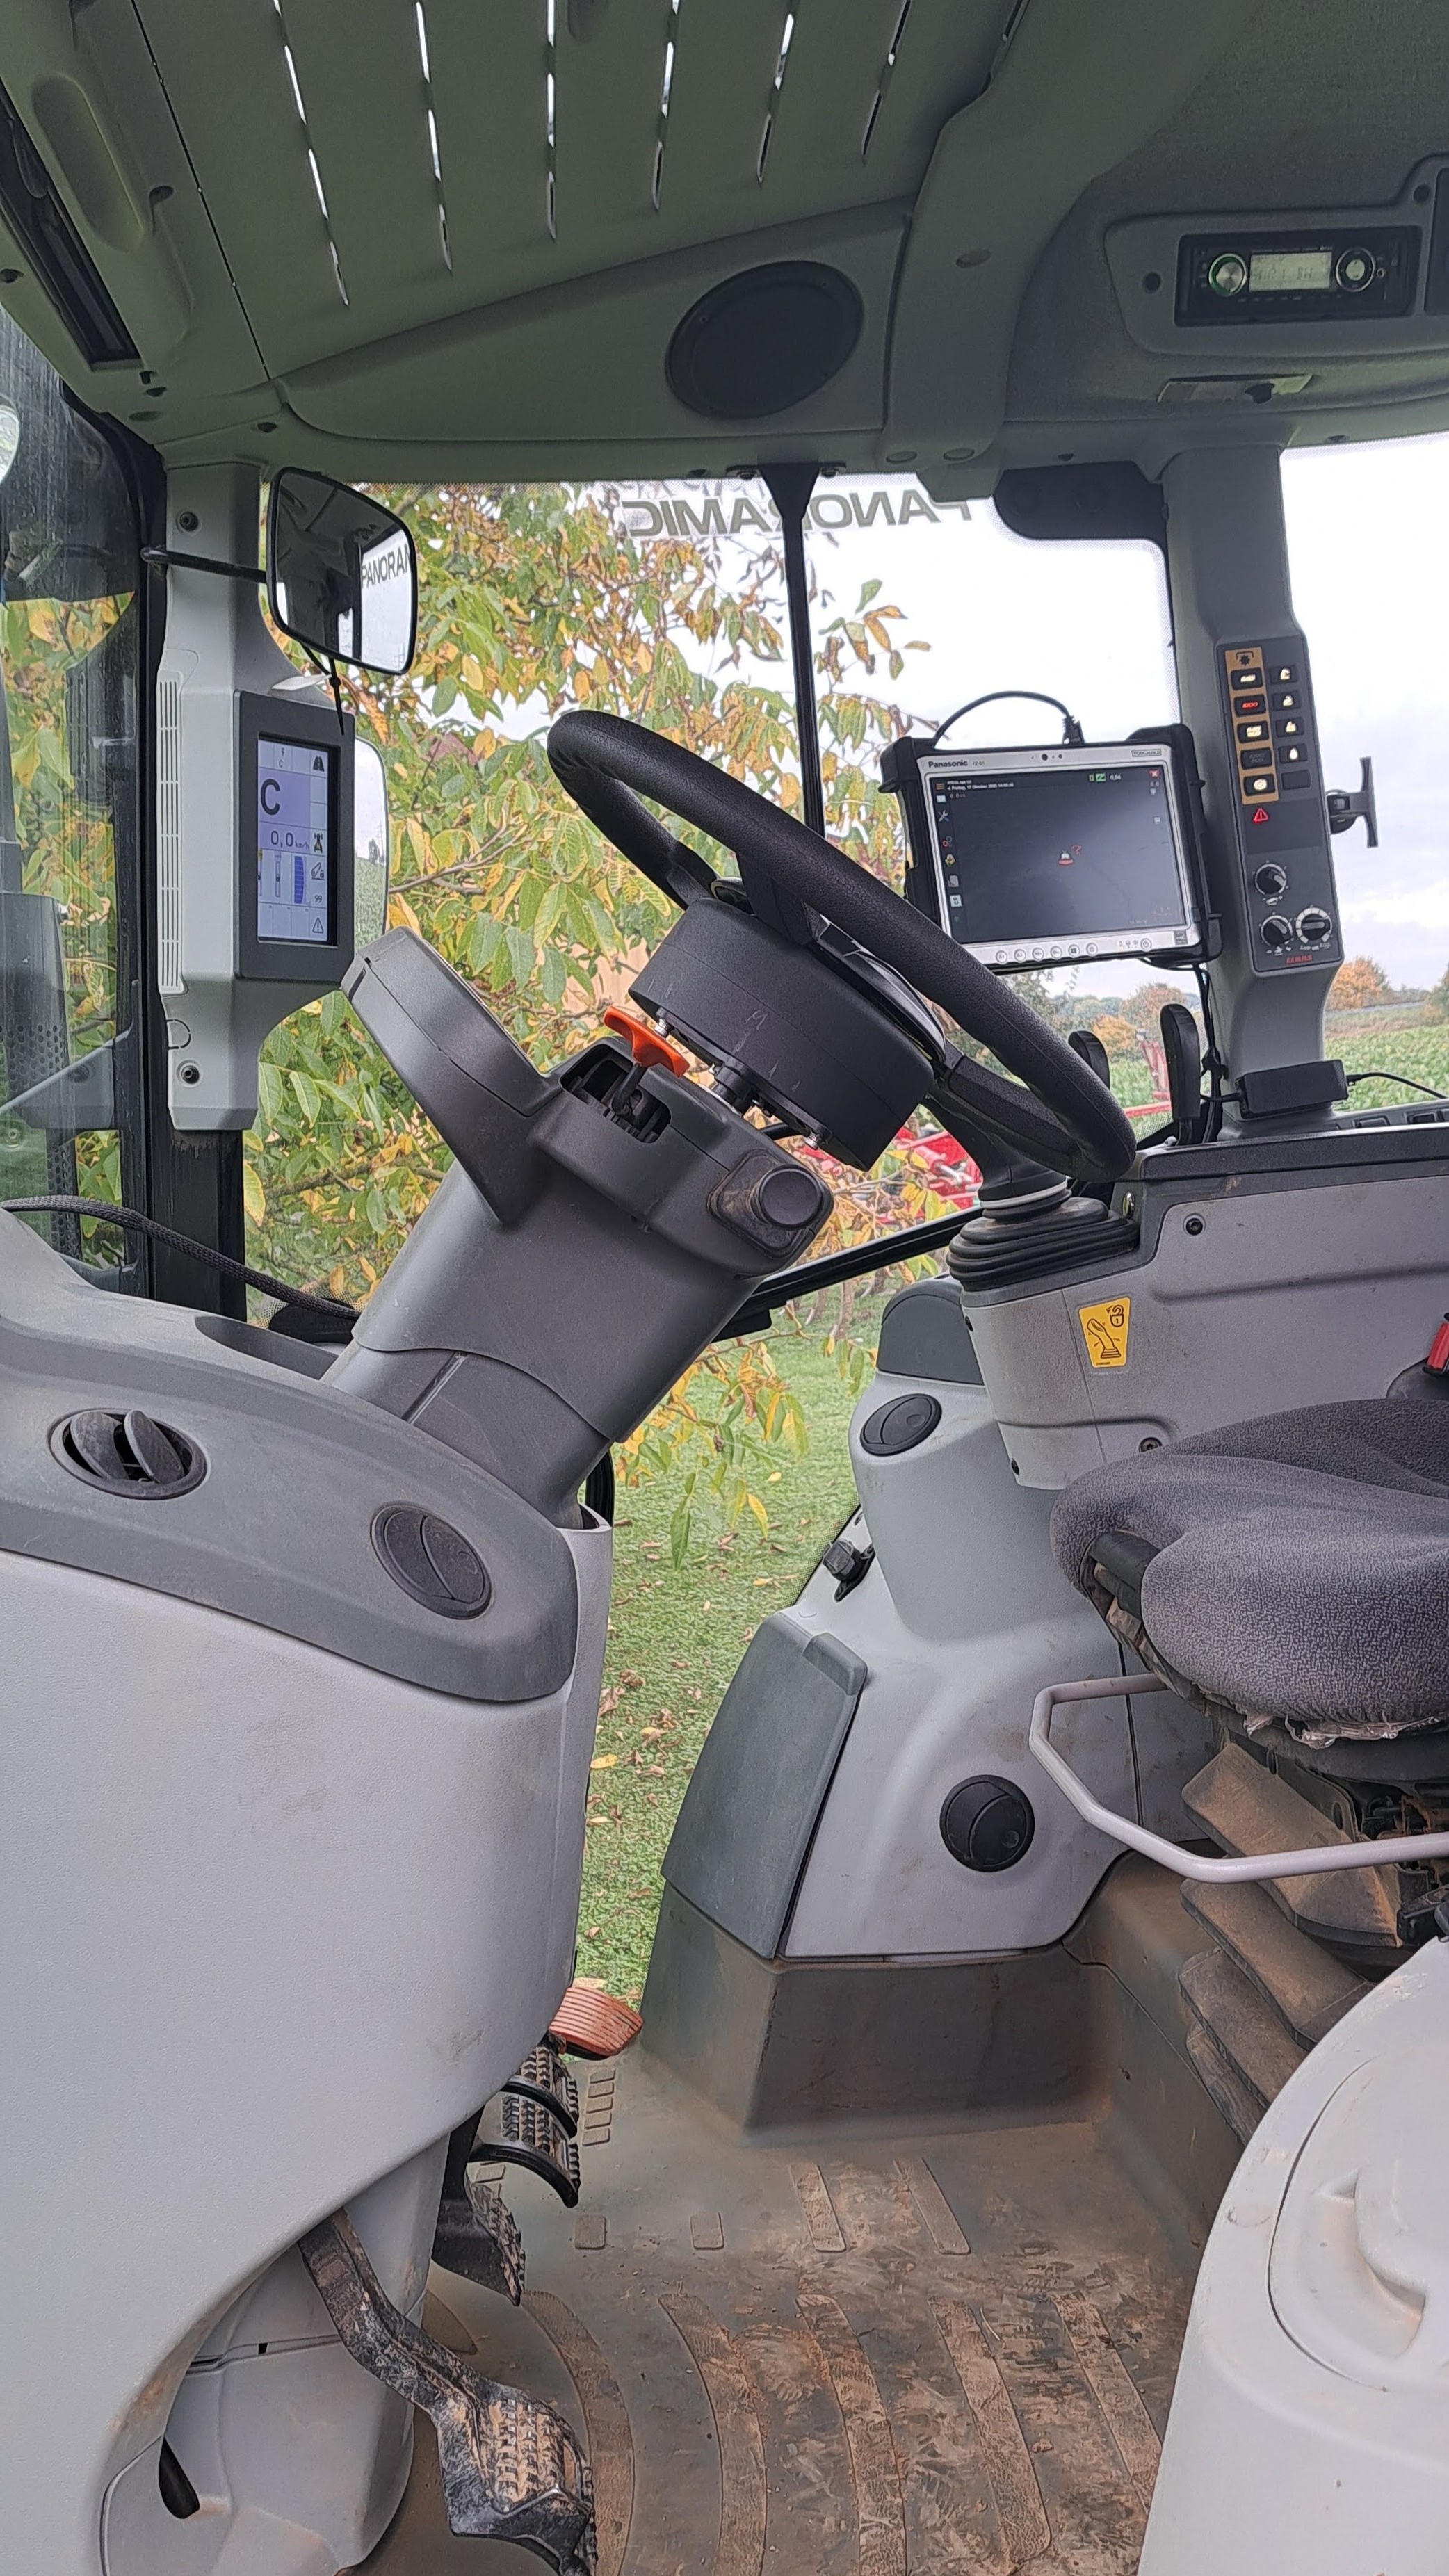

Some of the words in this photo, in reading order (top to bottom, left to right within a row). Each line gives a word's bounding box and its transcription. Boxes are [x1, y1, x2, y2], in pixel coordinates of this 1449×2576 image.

[928, 759, 969, 768] Panasonic
[260, 778, 281, 816] C
[270, 830, 293, 848] 0,0
[314, 894, 323, 903] 99
